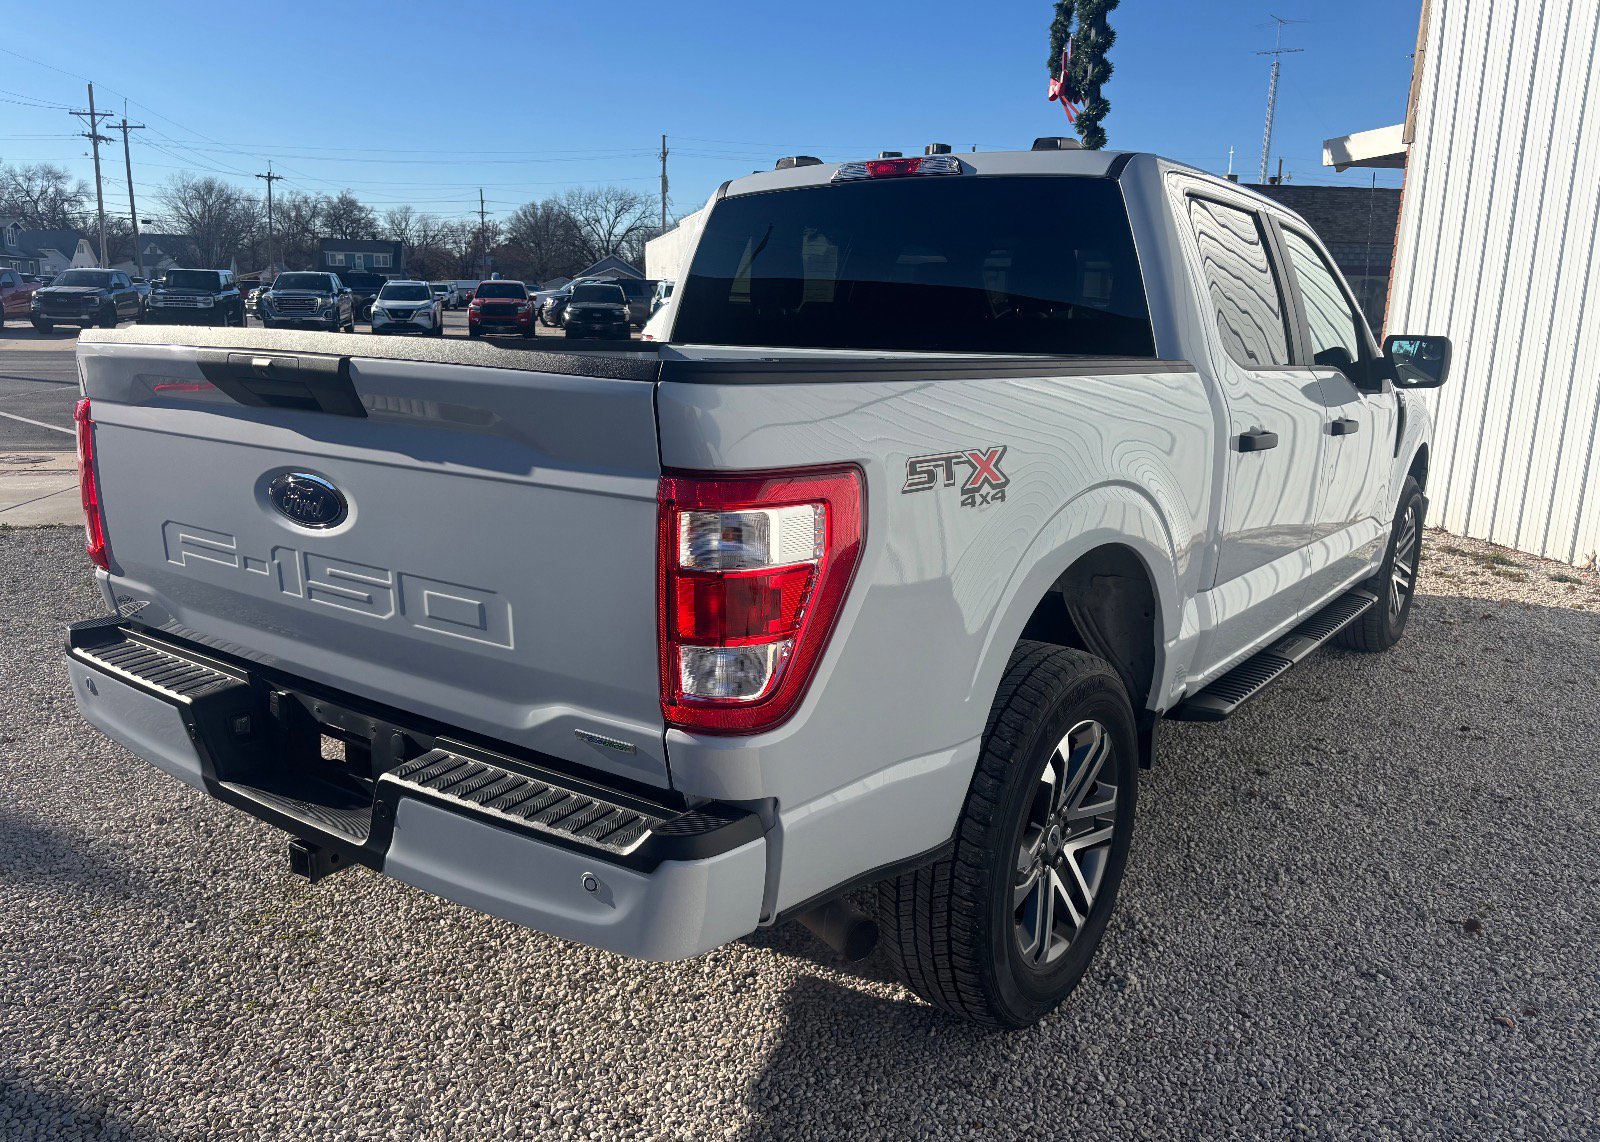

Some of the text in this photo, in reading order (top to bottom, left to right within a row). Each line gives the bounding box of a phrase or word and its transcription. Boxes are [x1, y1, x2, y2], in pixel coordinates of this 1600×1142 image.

[901, 445, 1010, 496] STX
[282, 482, 325, 518] Ford
[162, 519, 515, 650] F-150
